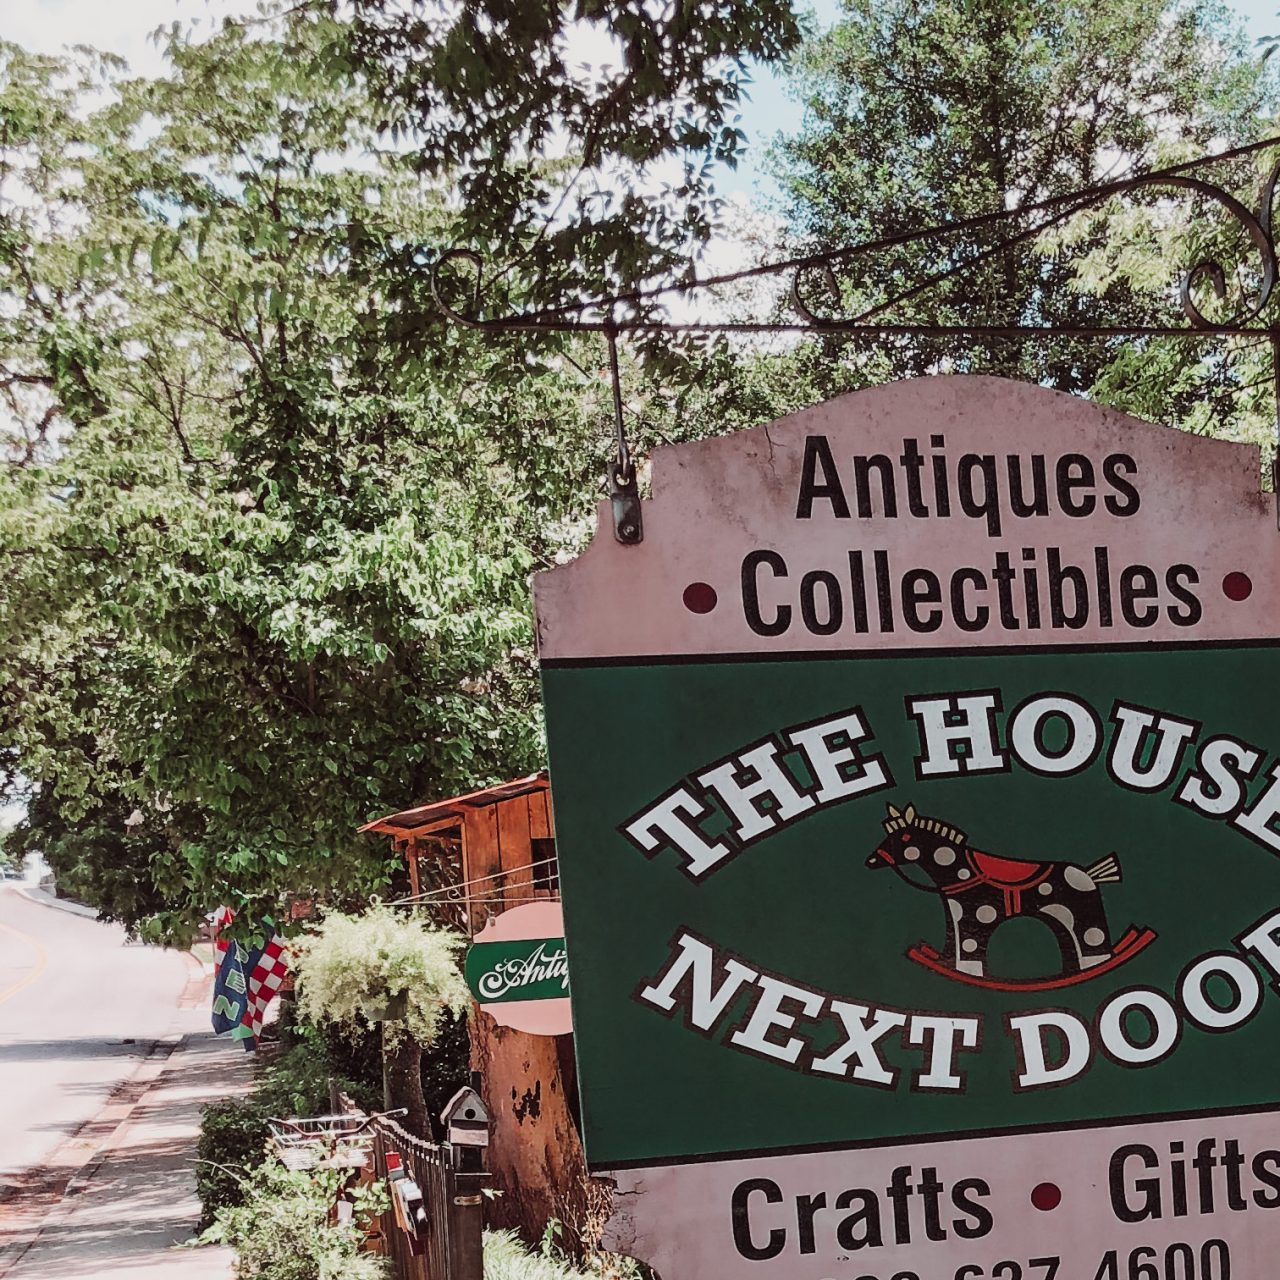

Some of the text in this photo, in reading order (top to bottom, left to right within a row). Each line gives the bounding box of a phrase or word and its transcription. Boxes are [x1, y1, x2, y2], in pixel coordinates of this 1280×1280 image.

[797, 434, 1142, 537] Antiques
[741, 547, 1203, 637] Collectibles
[624, 712, 890, 880] THE
[638, 934, 980, 1092] NEXT
[732, 1166, 993, 1261] Crafts
